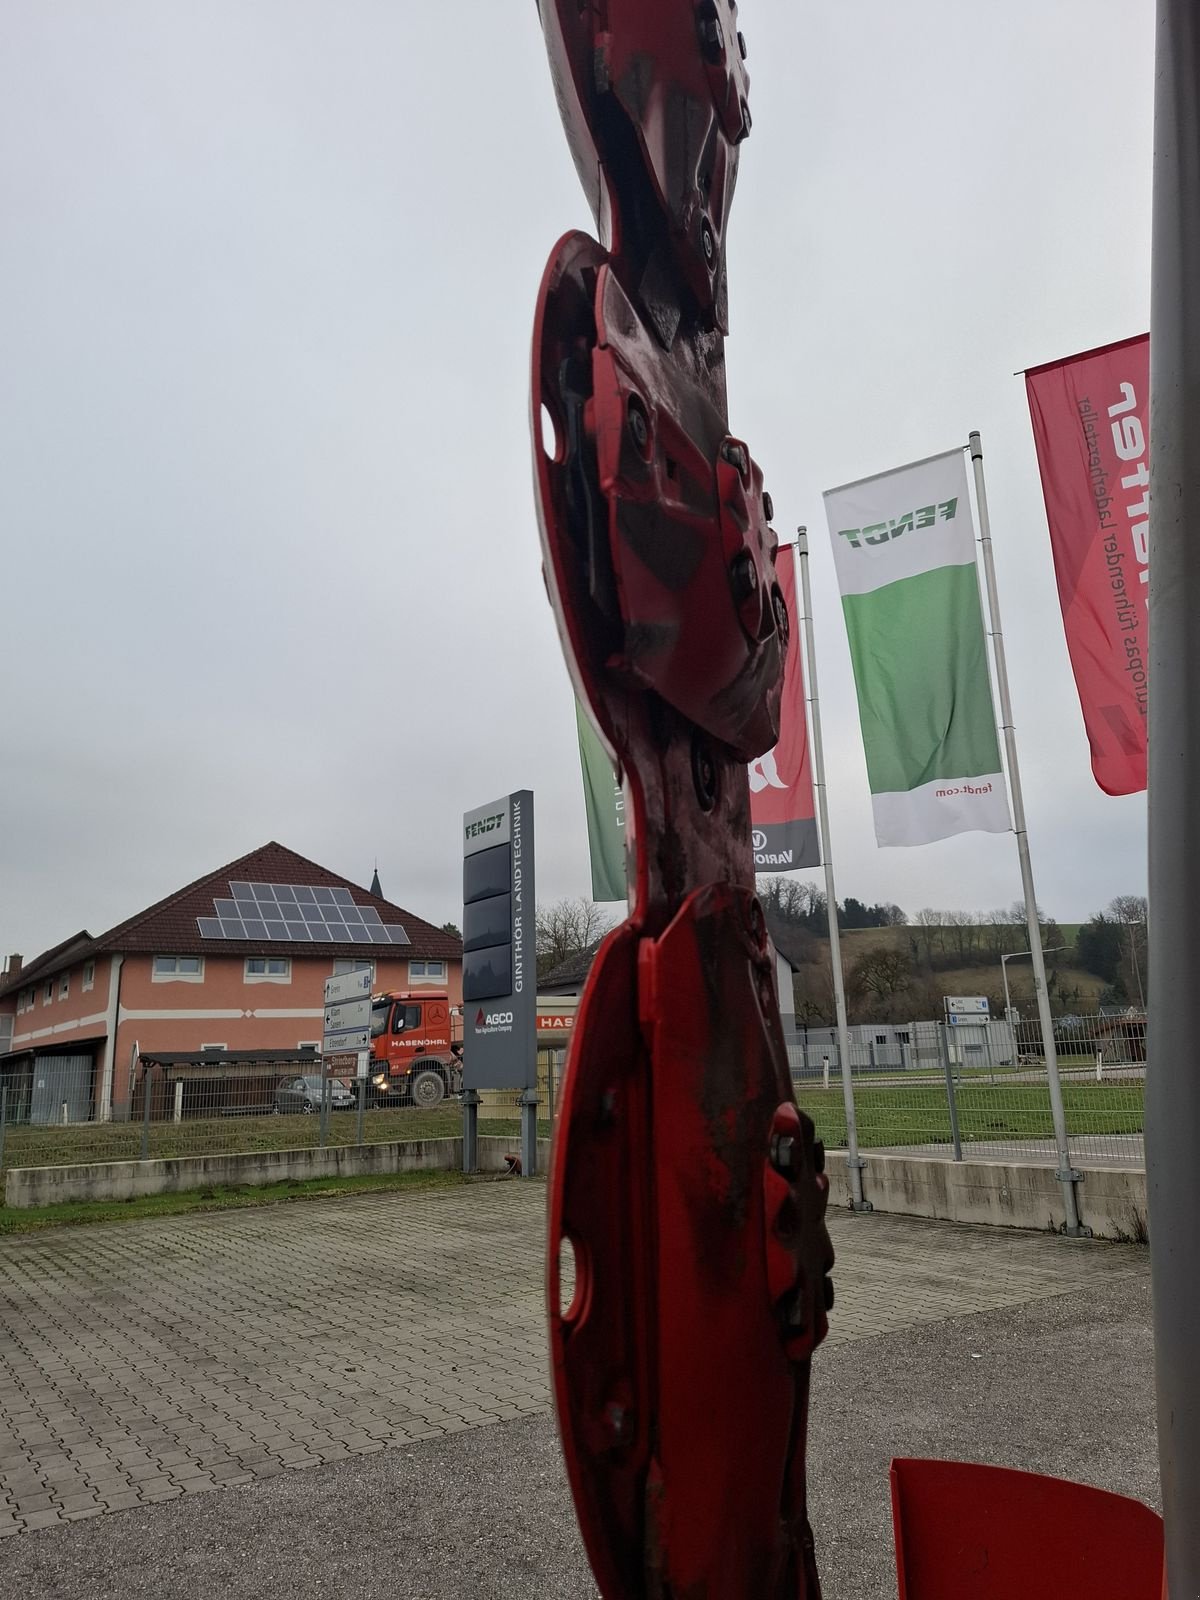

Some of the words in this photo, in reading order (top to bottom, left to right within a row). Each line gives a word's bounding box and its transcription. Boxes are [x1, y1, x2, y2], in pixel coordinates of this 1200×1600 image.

[465, 812, 505, 840] FENDT
[512, 799, 522, 912] LANDTECHNIK
[514, 917, 523, 993] GINTHÖR
[486, 1012, 513, 1026] AGCO
